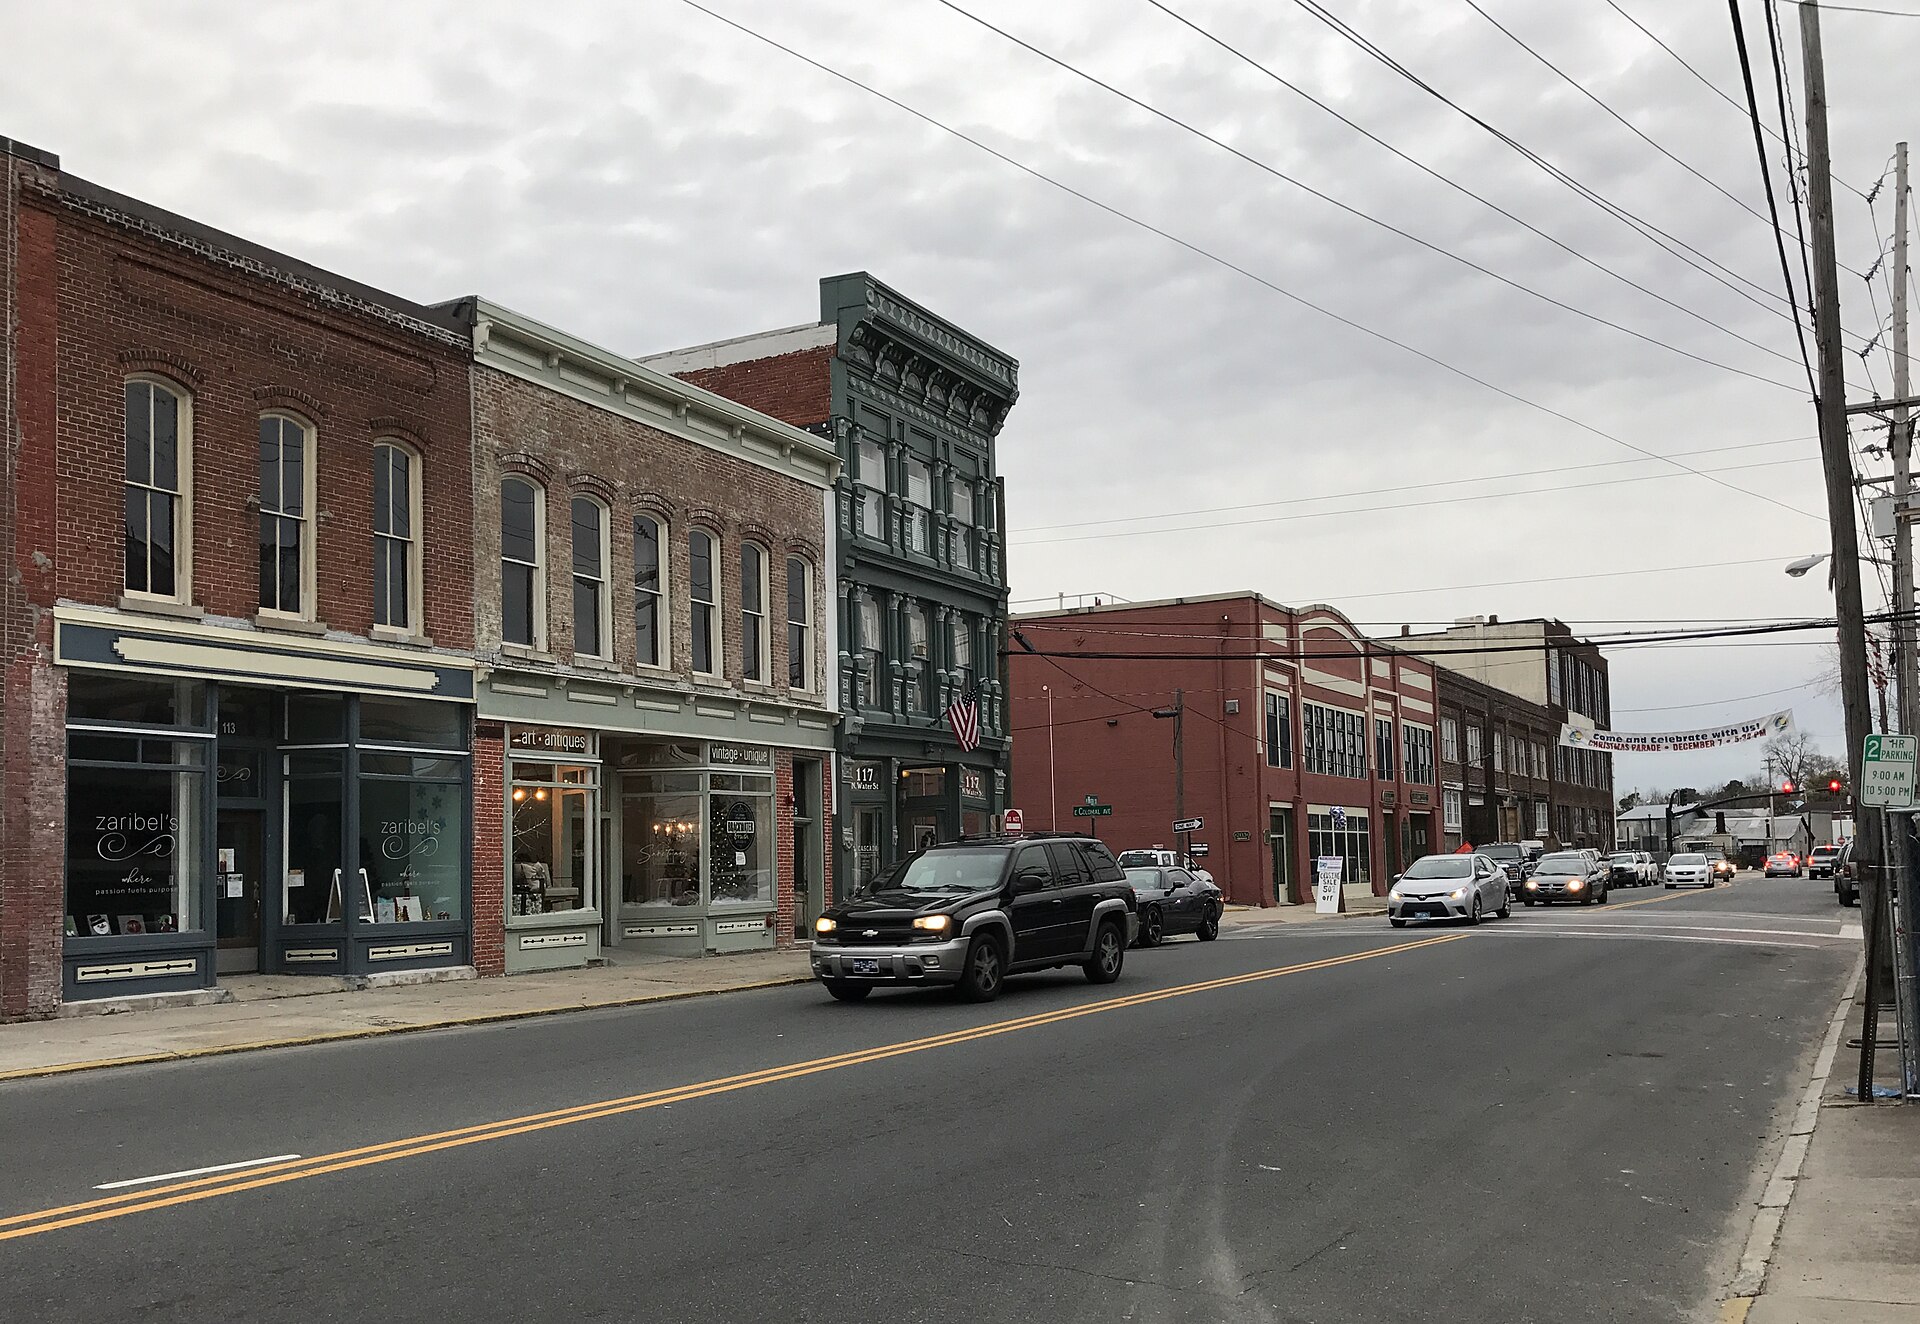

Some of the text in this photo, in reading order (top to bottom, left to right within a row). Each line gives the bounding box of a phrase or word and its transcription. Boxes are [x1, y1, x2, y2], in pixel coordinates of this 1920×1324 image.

[222, 722, 236, 734] 113
[521, 730, 586, 751] art antiques
[1593, 733, 1624, 743] Come
[1626, 736, 1648, 744] and
[1650, 733, 1708, 744] Celebrate
[1711, 728, 1738, 739] with
[1588, 740, 1630, 752] CHRISTMAS
[1632, 744, 1662, 752] PARADE
[1672, 740, 1716, 751] DECEMBER
[1868, 739, 1905, 758] 2 HR
[711, 744, 768, 765] vintage unique
[1881, 750, 1914, 760] PARKING
[856, 768, 874, 782] 117
[965, 775, 980, 789] 117
[1872, 770, 1905, 781] 9:00 AM
[1866, 785, 1910, 797] TO 5:00 PM
[96, 812, 178, 831] zaribel's
[381, 819, 441, 835] zaribel's
[121, 867, 152, 884] where
[399, 863, 420, 878] where
[96, 888, 126, 896] passion
[127, 887, 146, 895] fuels
